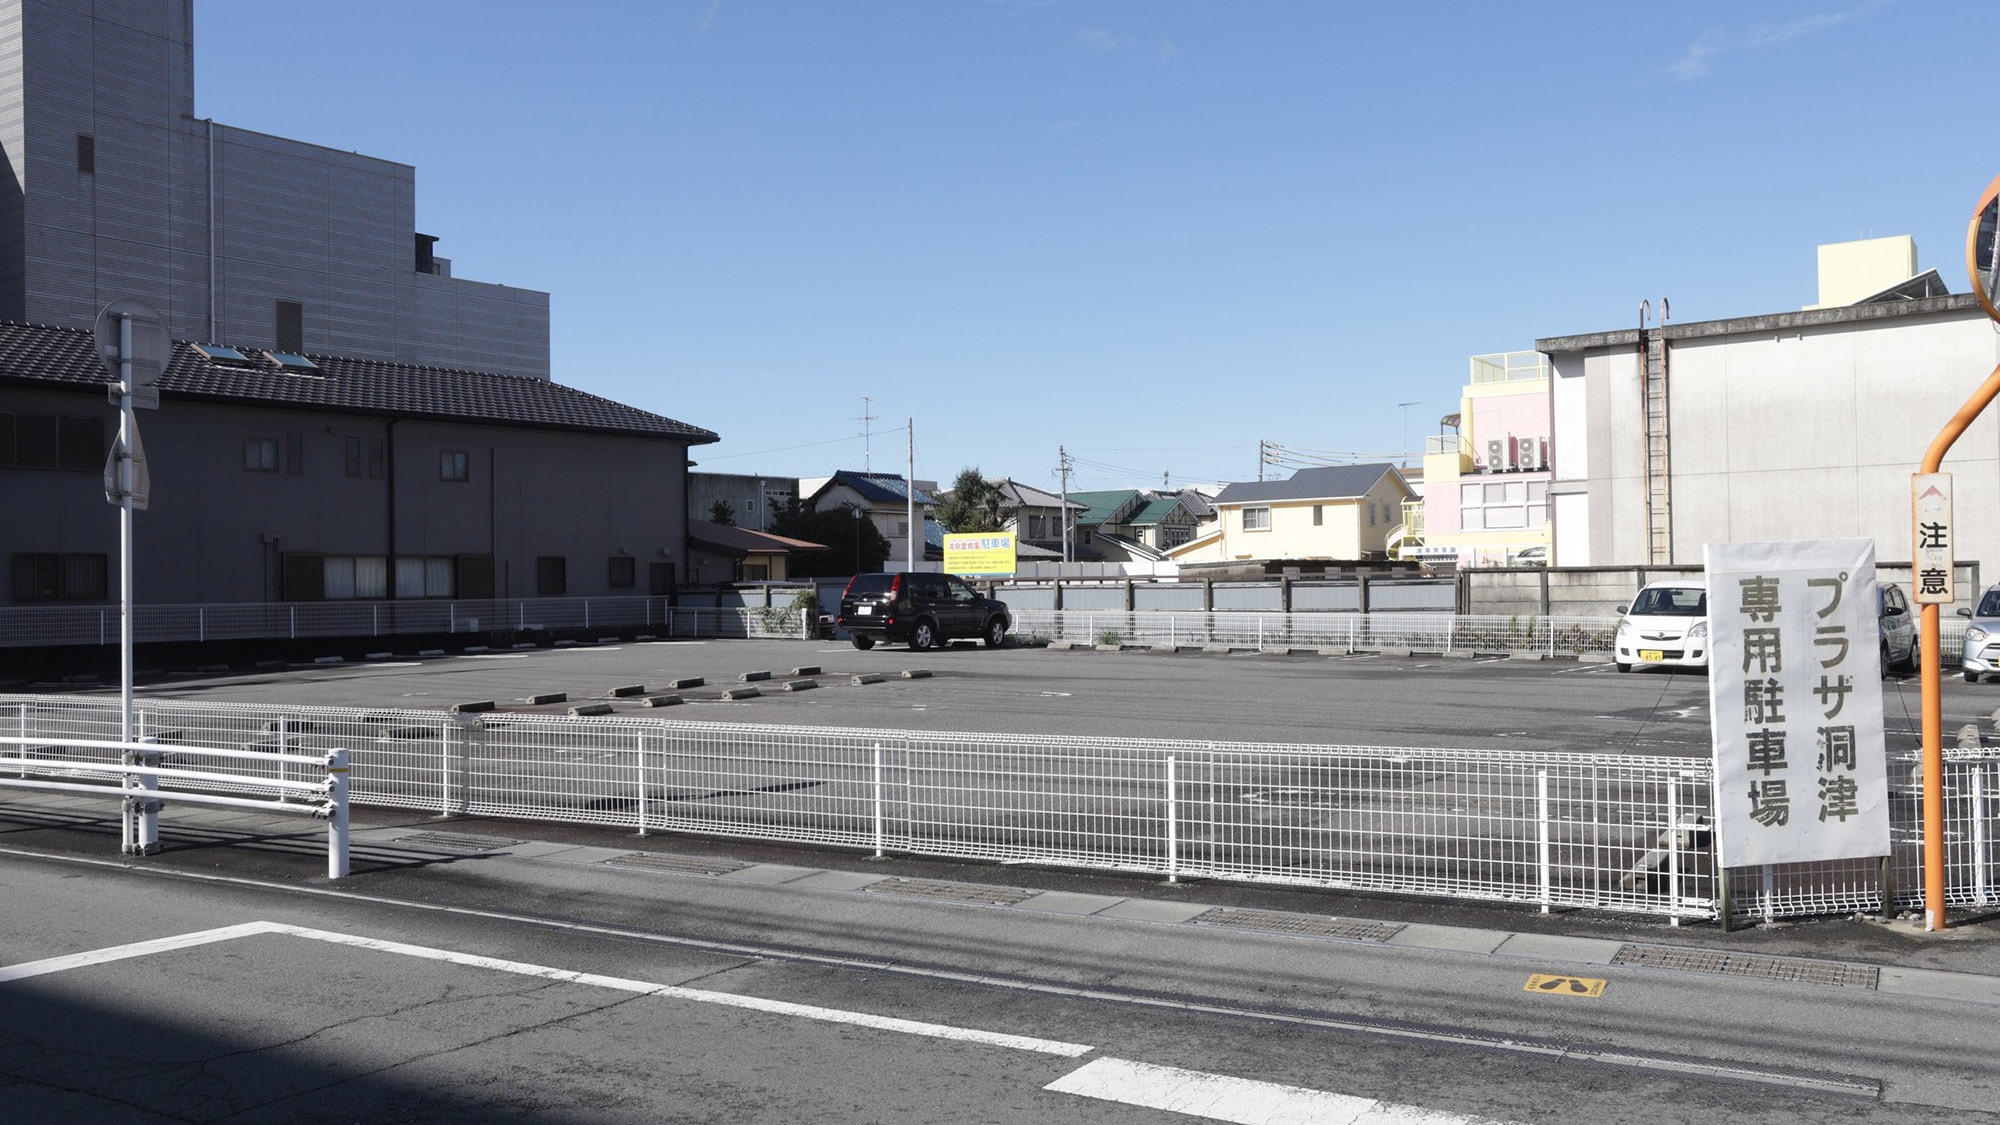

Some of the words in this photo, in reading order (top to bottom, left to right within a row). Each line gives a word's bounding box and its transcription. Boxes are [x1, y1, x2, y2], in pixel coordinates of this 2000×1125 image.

[981, 537, 1011, 549] 駐車場
[1919, 521, 1948, 595] 注意
[1738, 575, 1791, 828] 専用駐車場
[1807, 571, 1860, 824] プラザ洞津
